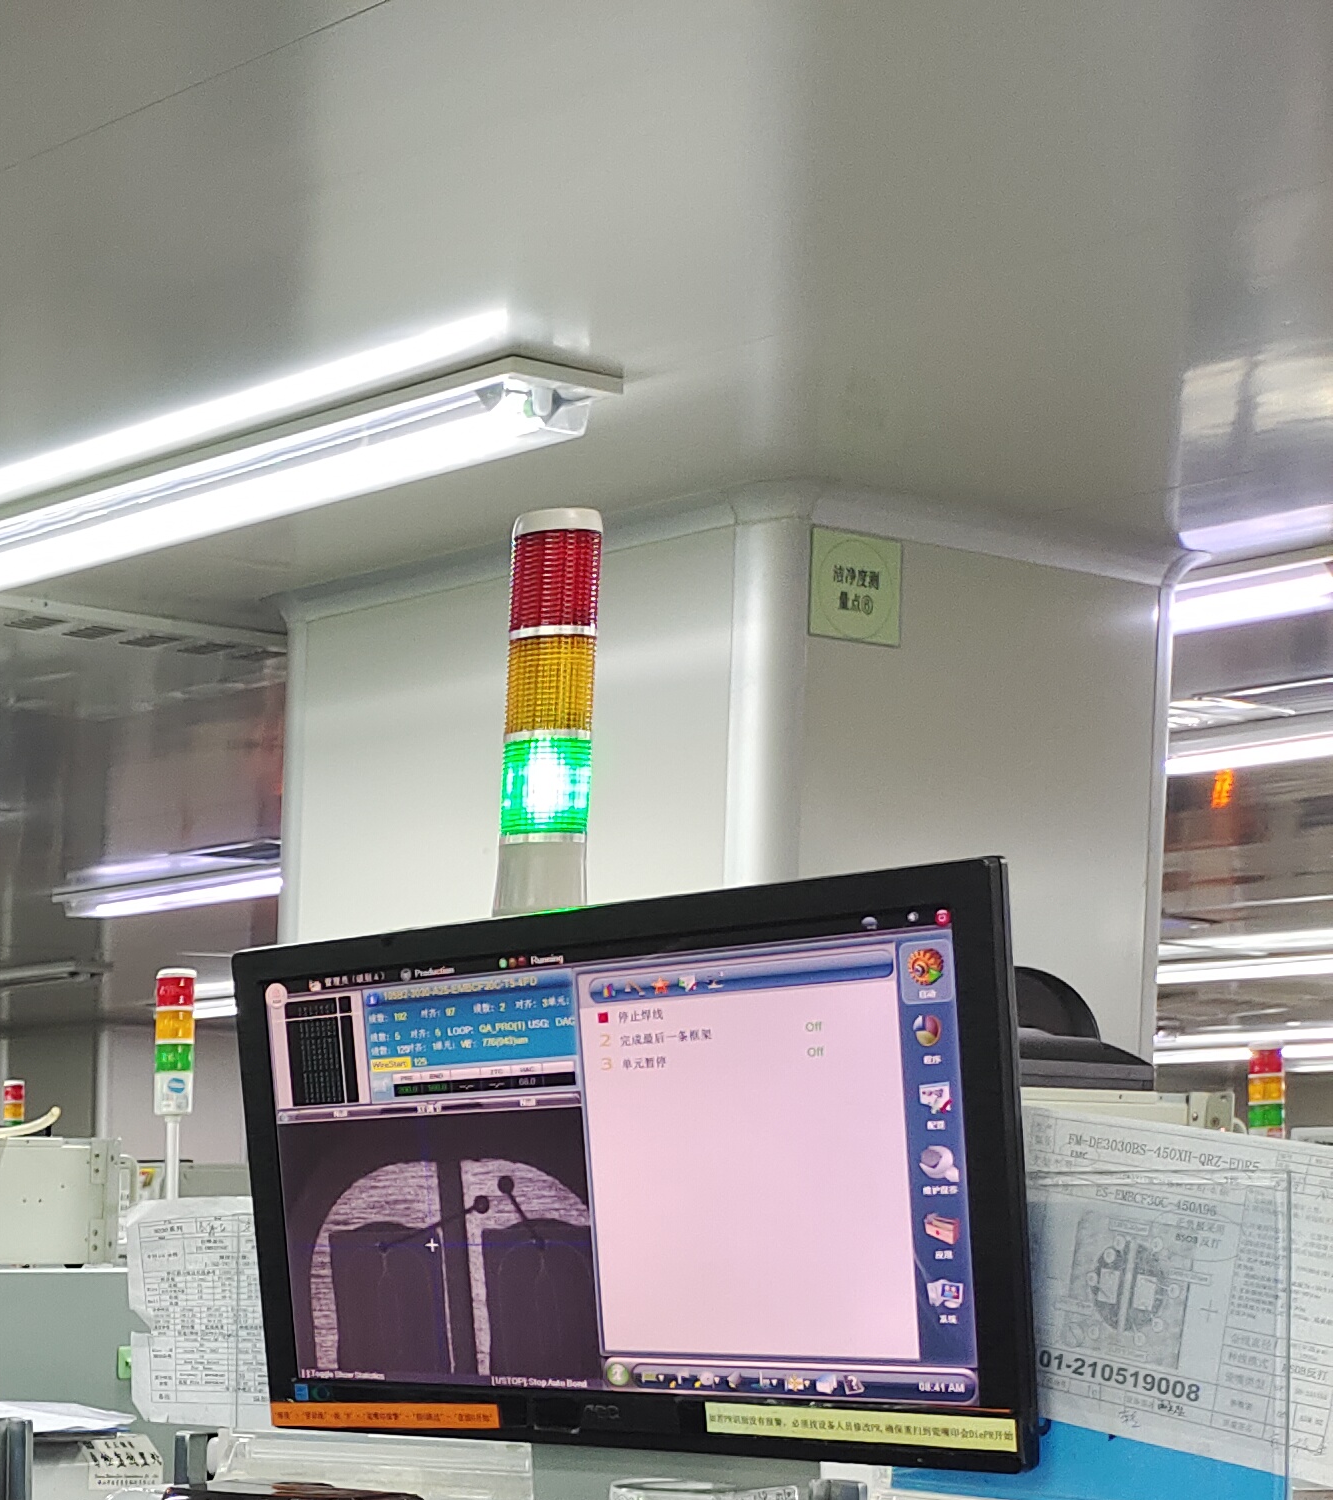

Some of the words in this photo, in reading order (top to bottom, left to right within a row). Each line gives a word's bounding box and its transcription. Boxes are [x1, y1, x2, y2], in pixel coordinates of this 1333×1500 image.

[833, 564, 881, 590] 洁净度测
[530, 954, 564, 965] Running
[414, 966, 455, 978] Production
[618, 1008, 664, 1024] 停止焊线
[805, 1021, 823, 1033] Off
[600, 1034, 612, 1047] 2
[620, 1029, 713, 1047] 完成最后一条框架
[807, 1046, 825, 1058] Off
[601, 1057, 613, 1071] 3
[622, 1056, 667, 1070] 单元暂停
[1038, 1350, 1201, 1402] 01-210519008
[947, 1382, 966, 1394] AM
